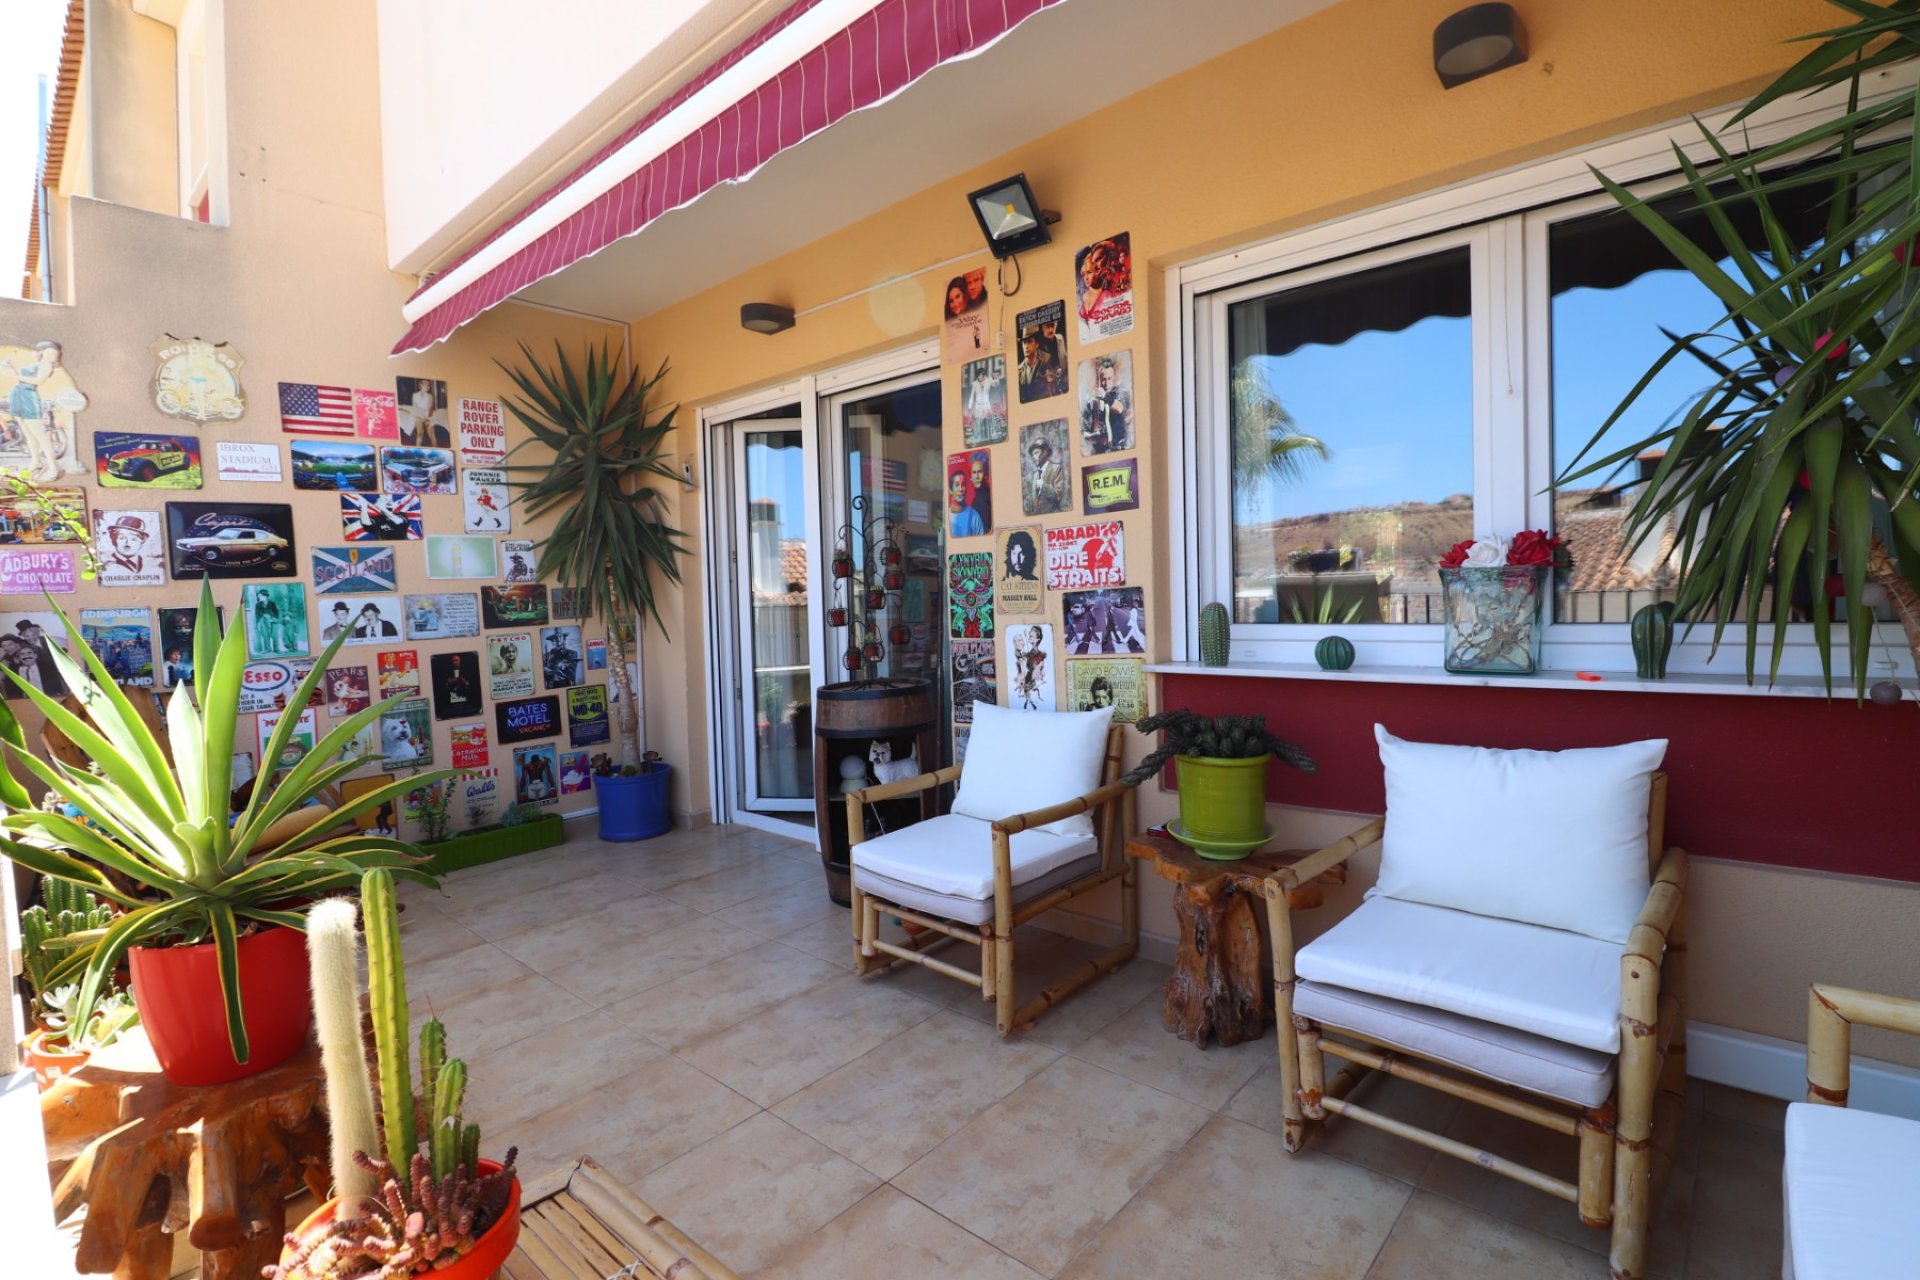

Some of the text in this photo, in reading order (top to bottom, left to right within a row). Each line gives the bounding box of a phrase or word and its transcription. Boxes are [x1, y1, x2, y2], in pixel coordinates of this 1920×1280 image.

[463, 400, 498, 413] RANGE
[464, 412, 498, 424] ROVER
[461, 423, 504, 437] PARKING
[220, 443, 255, 453] IBROX
[471, 436, 495, 448] ONLY
[221, 455, 271, 465] STADIUM
[1092, 474, 1126, 490] R.E.M.
[194, 512, 251, 530] Capri
[1048, 551, 1089, 570] DIRE
[316, 557, 393, 582] SCOTLAND
[16, 572, 72, 584] CHOCOLATE
[1048, 567, 1122, 588] STRAITS
[82, 609, 149, 618] EDINBURGH
[1104, 666, 1135, 676] BOWIE
[508, 703, 548, 717] BATES
[507, 713, 551, 728] MOTEL
[466, 780, 496, 798] Wall's
